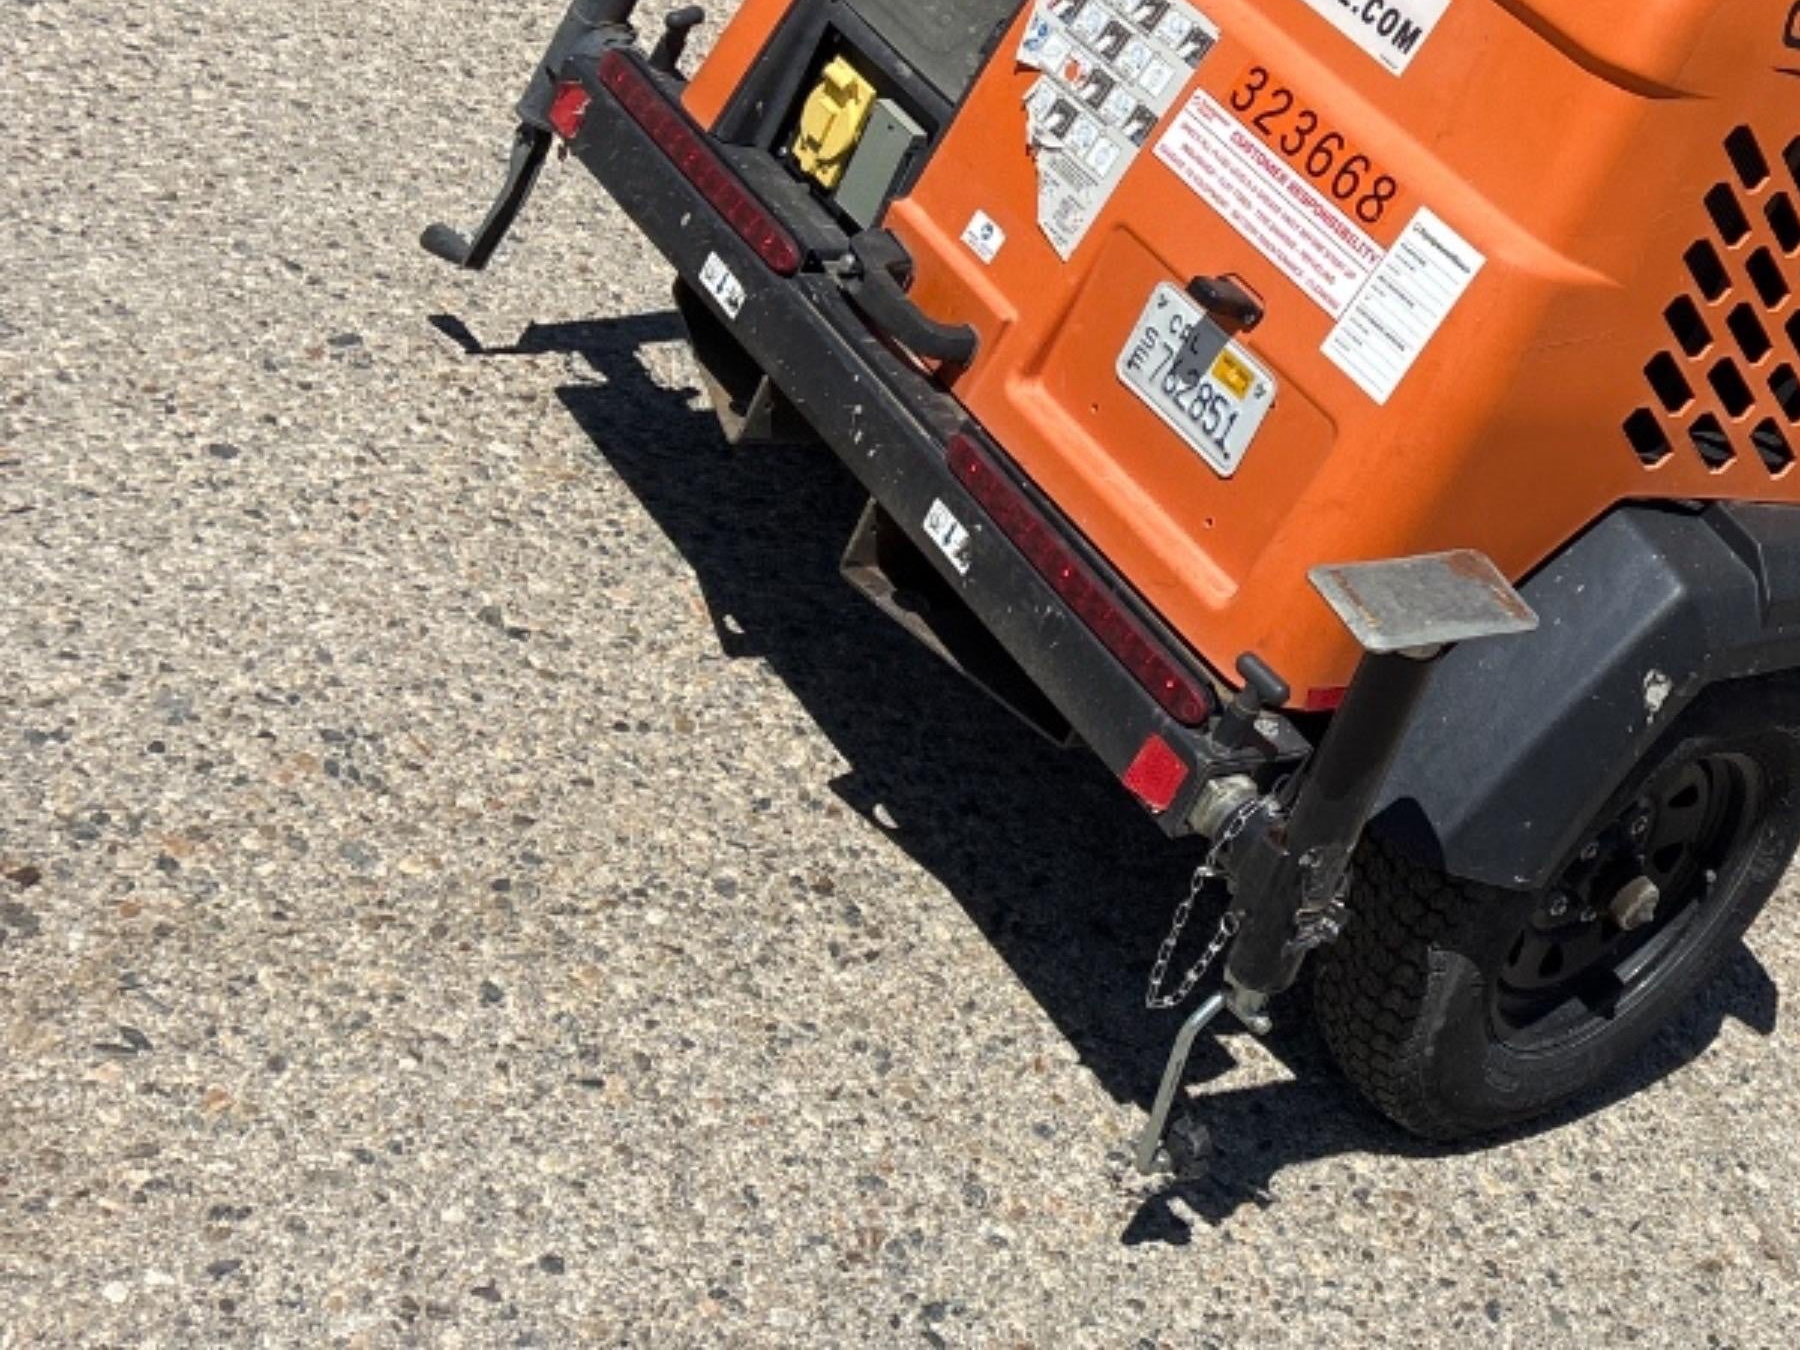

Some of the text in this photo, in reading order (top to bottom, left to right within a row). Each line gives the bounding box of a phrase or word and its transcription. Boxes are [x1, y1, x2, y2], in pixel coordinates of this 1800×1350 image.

[1230, 67, 1396, 223] 323668
[1230, 131, 1288, 186] CUSTOMER
[1286, 178, 1381, 266] RESPONSIBILITY
[1169, 314, 1200, 354] CAL
[1149, 341, 1238, 450] 762851
